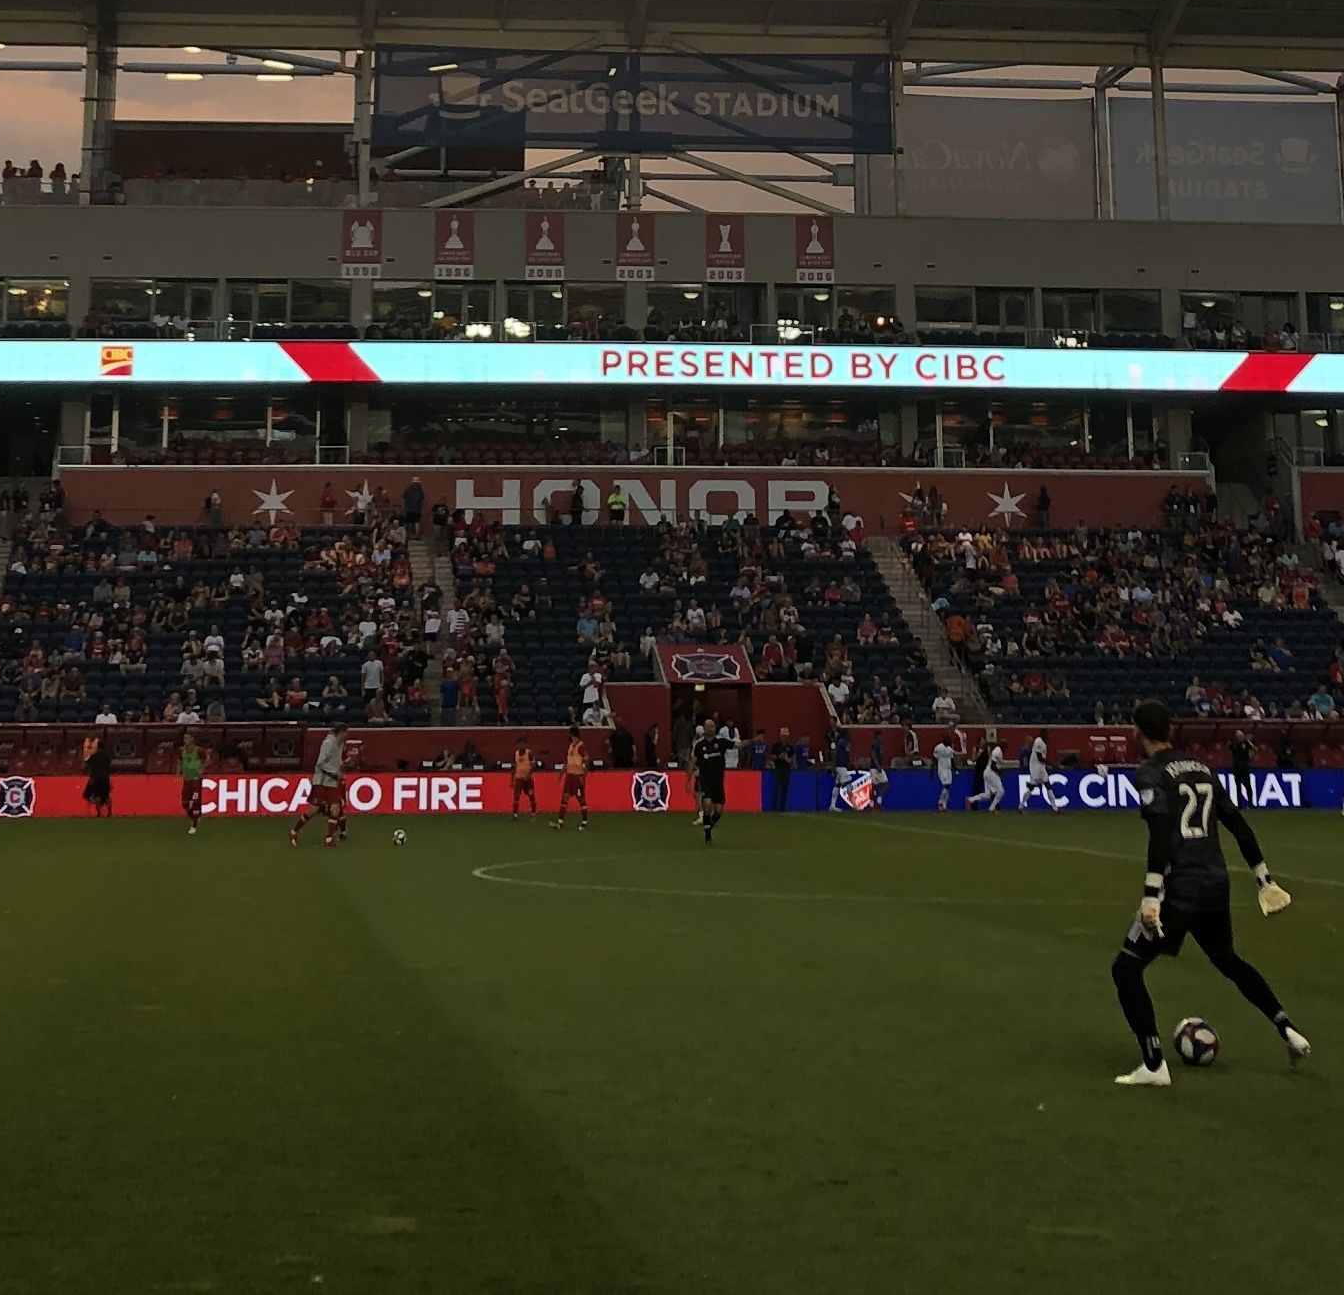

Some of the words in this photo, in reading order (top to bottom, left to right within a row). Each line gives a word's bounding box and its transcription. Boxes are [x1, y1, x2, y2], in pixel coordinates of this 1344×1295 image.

[501, 81, 680, 116] SeatGeek
[694, 91, 840, 118] STADIUM
[602, 350, 834, 379] PRESENTED
[850, 353, 899, 380] BY
[915, 354, 1007, 381] CIBC
[455, 479, 833, 526] HONOR
[200, 777, 382, 813] CHICAO
[393, 776, 485, 811] FIRE
[1178, 782, 1214, 839] 27
